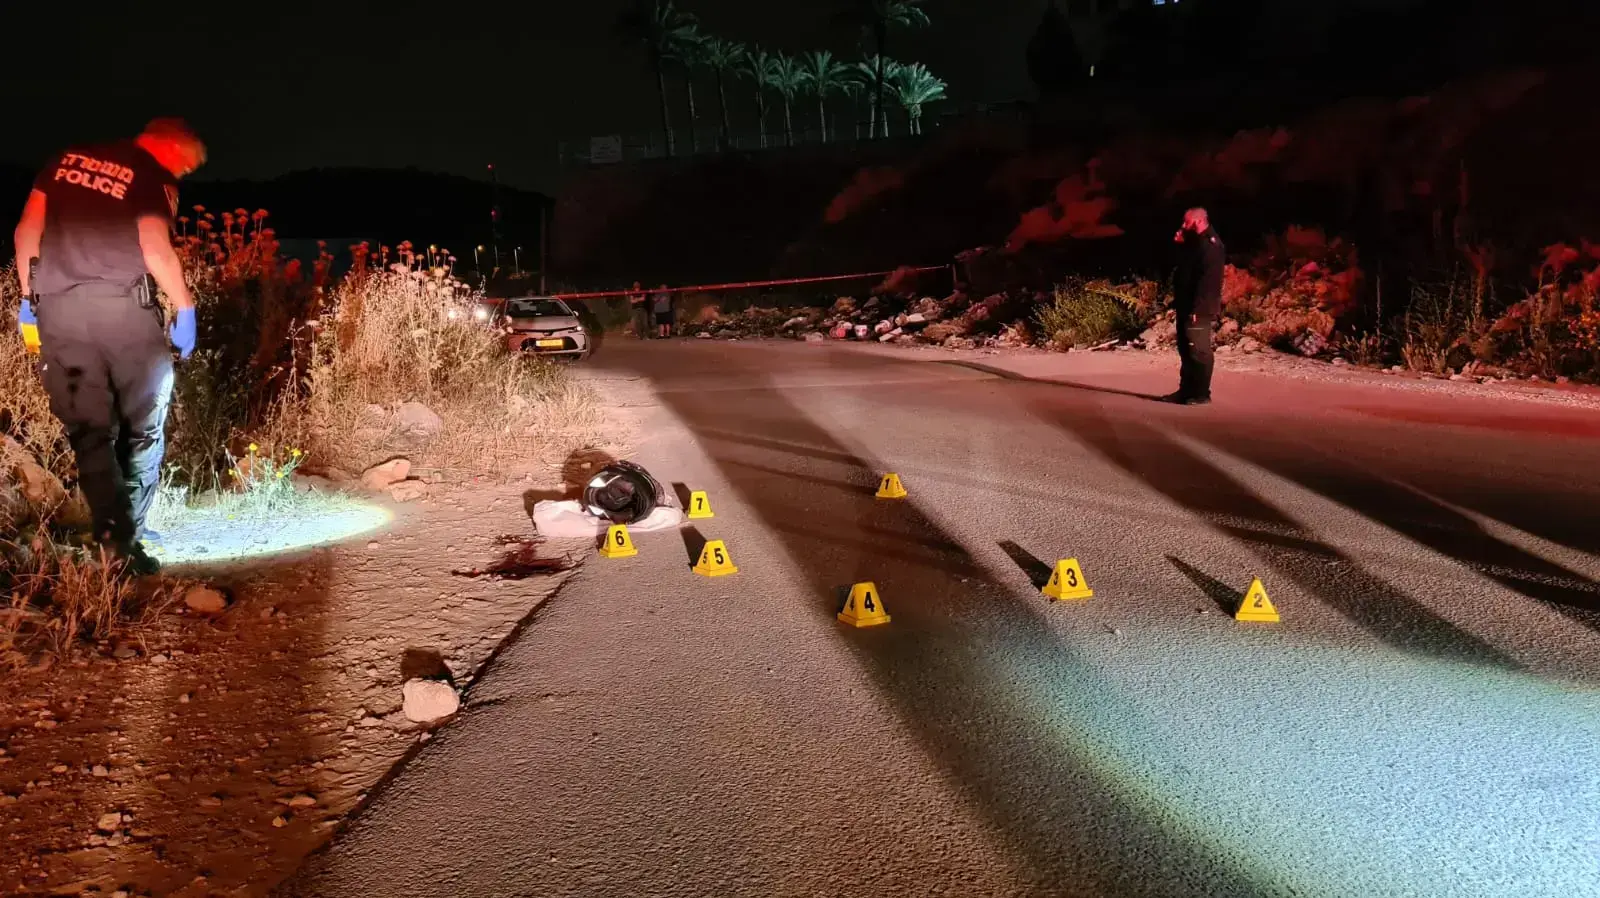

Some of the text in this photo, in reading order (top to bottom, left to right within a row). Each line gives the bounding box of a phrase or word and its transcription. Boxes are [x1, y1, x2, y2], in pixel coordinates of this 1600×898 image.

[54, 168, 127, 200] POLICE
[884, 478, 890, 490] 1
[696, 498, 703, 511] 7
[615, 530, 625, 546] 6
[714, 548, 724, 565] 5
[1066, 568, 1078, 587] 3
[864, 591, 875, 613] 4
[1253, 592, 1263, 608] 2
